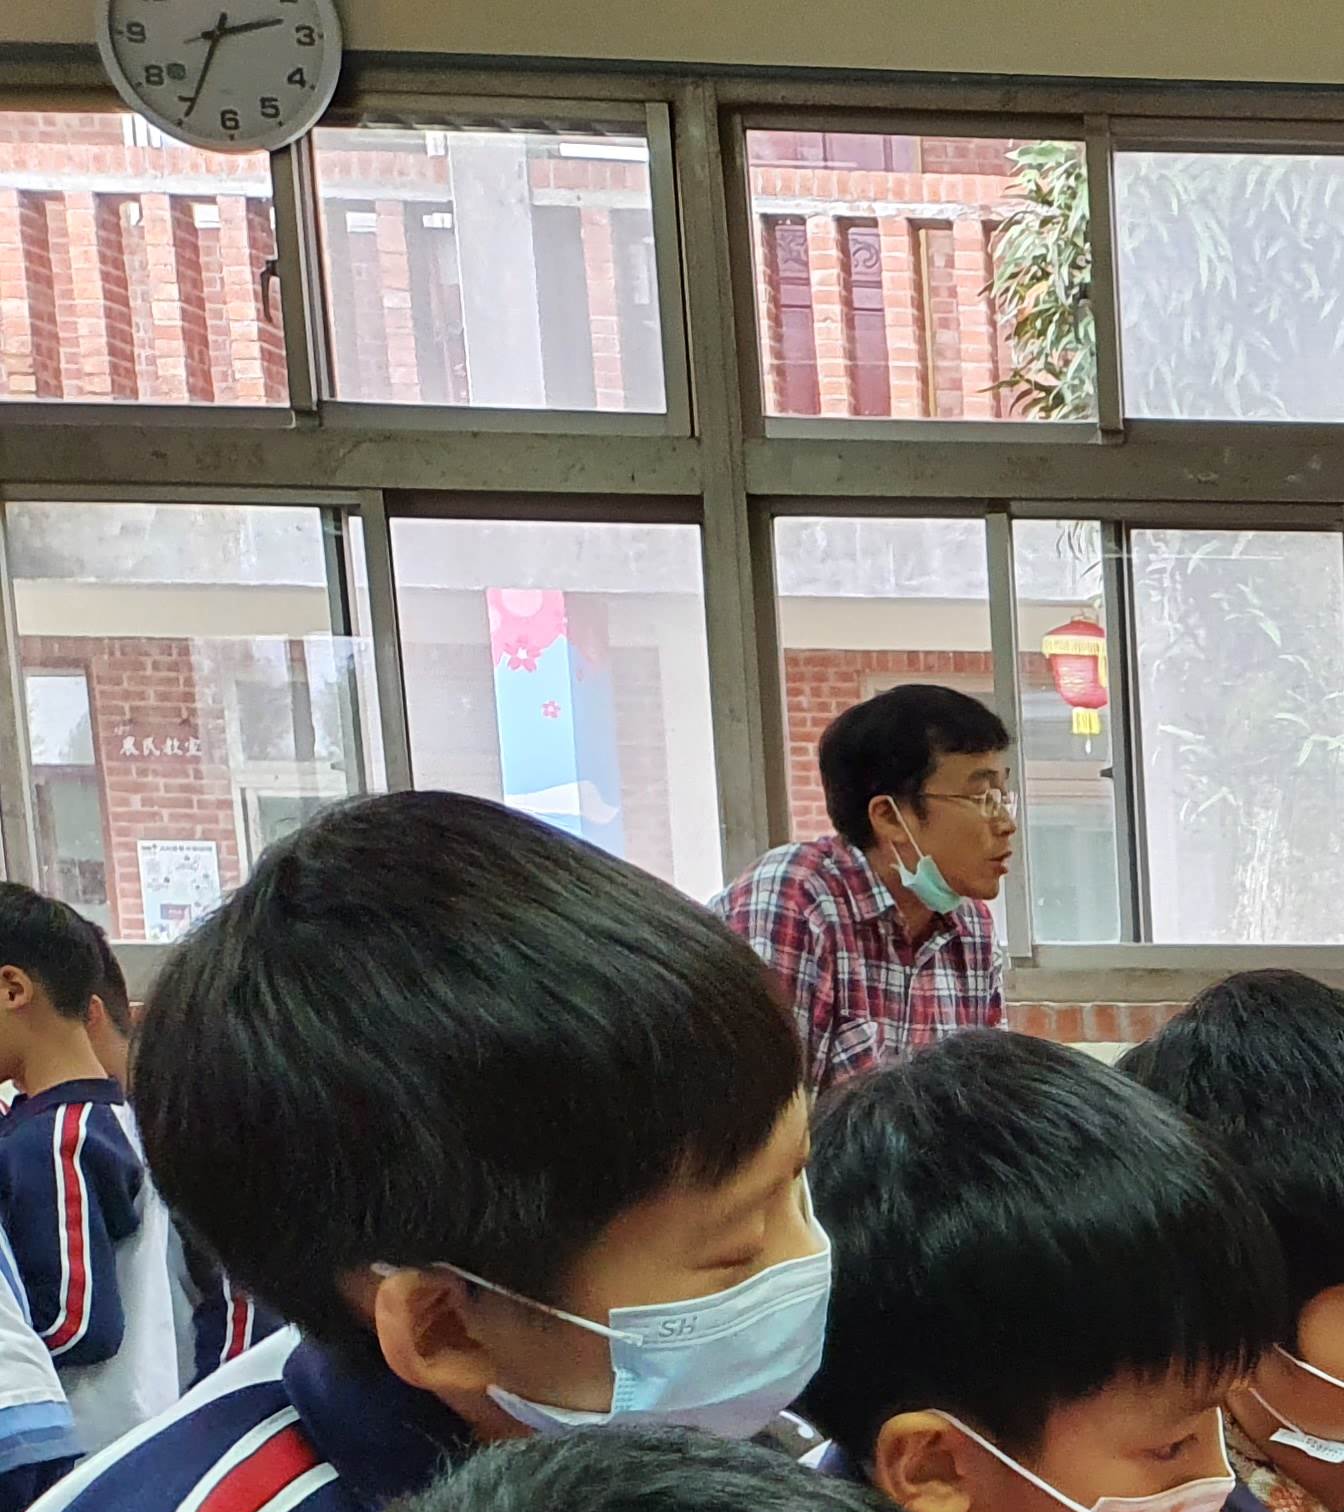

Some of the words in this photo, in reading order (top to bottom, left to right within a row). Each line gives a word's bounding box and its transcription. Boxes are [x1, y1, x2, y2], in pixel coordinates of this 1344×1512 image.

[126, 21, 146, 43] 9
[295, 24, 316, 46] 3
[144, 64, 164, 86] 8
[287, 67, 306, 88] 4
[260, 96, 280, 118] 5
[220, 109, 240, 130] 6
